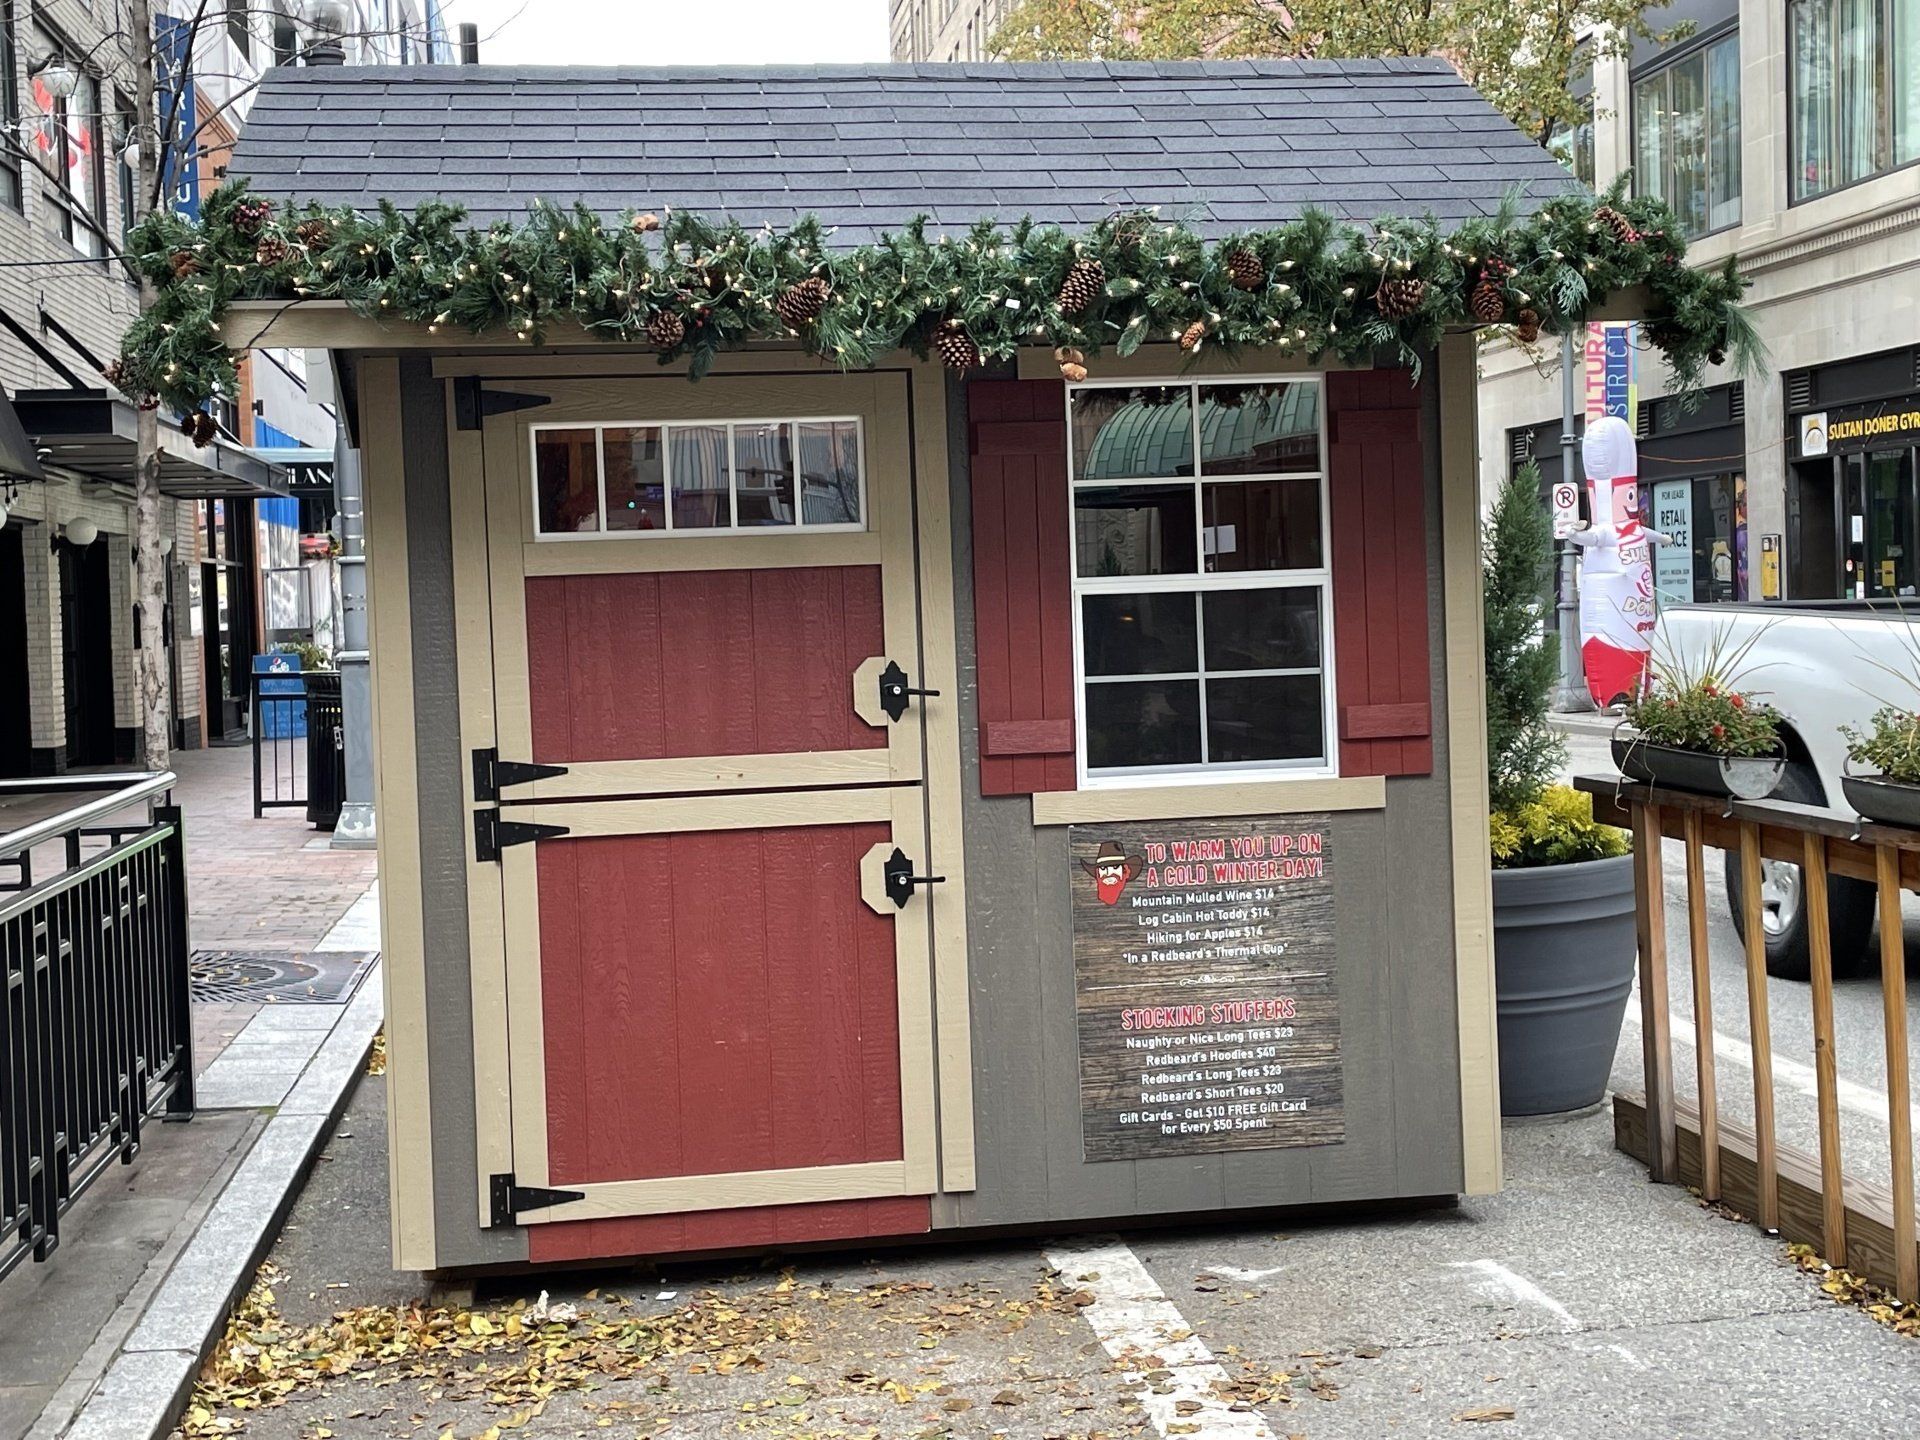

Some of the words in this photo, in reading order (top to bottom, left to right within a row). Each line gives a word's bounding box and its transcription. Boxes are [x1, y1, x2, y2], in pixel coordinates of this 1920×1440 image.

[1828, 420, 1863, 440] SULTAN
[1864, 414, 1898, 435] DONER
[286, 468, 334, 484] ILAN
[1661, 490, 1671, 500] FOR
[1671, 489, 1685, 499] LEASE
[1661, 509, 1686, 527] RETAIL
[1661, 531, 1687, 548] ACE
[1145, 842, 1166, 864] TO
[1172, 839, 1225, 862] WARM
[1230, 835, 1265, 859] YOU
[1270, 834, 1293, 857] UP
[1298, 832, 1322, 855] ON
[1147, 867, 1158, 888] A
[1164, 863, 1207, 886] COLD
[1213, 859, 1278, 884] WINTER
[1283, 857, 1323, 880] DAY!
[1132, 894, 1183, 908] Mountain
[1186, 892, 1223, 905] Mulled
[1225, 890, 1252, 902] Wine
[1255, 888, 1275, 901] $14
[1138, 915, 1159, 927] Log
[1162, 912, 1193, 924] Cabin
[1195, 910, 1215, 922] Hot
[1216, 908, 1248, 921] Toddy
[1250, 907, 1270, 919] $14
[1147, 931, 1183, 944] Hiking
[1185, 930, 1201, 941] for
[1203, 927, 1242, 940] Apples
[1243, 925, 1264, 939] $14
[1141, 955, 1148, 963] a
[1151, 948, 1212, 962] Redbeard's
[1215, 945, 1260, 958] Thermal
[1121, 1004, 1206, 1030] STOCKING
[1211, 997, 1296, 1024] STUFFERS
[1126, 1036, 1172, 1050] Naughty
[1174, 1035, 1187, 1045] or
[1189, 1033, 1214, 1045] Nice
[1217, 1031, 1244, 1044] Long
[1246, 1028, 1271, 1040] Tees
[1274, 1026, 1294, 1040] $23
[1146, 1051, 1207, 1066] Redbeard's
[1210, 1048, 1254, 1062] Hoodies
[1256, 1046, 1276, 1060] $40
[1141, 1071, 1202, 1085] Redbeard's
[1205, 1069, 1232, 1082] Long
[1235, 1067, 1260, 1078] Tees
[1262, 1064, 1282, 1078] $23
[1141, 1089, 1202, 1104] Redbeard's
[1205, 1086, 1235, 1099] Short
[1237, 1085, 1262, 1096] Tees
[1264, 1083, 1285, 1096] $20
[1119, 1111, 1139, 1124] Gift
[1142, 1110, 1174, 1122] Cards
[1185, 1107, 1204, 1119] Get
[1205, 1105, 1225, 1118] $10
[1228, 1103, 1257, 1116] FREE
[1260, 1101, 1279, 1113] Gift
[1281, 1099, 1307, 1112] Card
[1161, 1123, 1176, 1134] for
[1180, 1122, 1211, 1134] Every
[1213, 1118, 1233, 1131] $50
[1235, 1117, 1267, 1130] Spent
